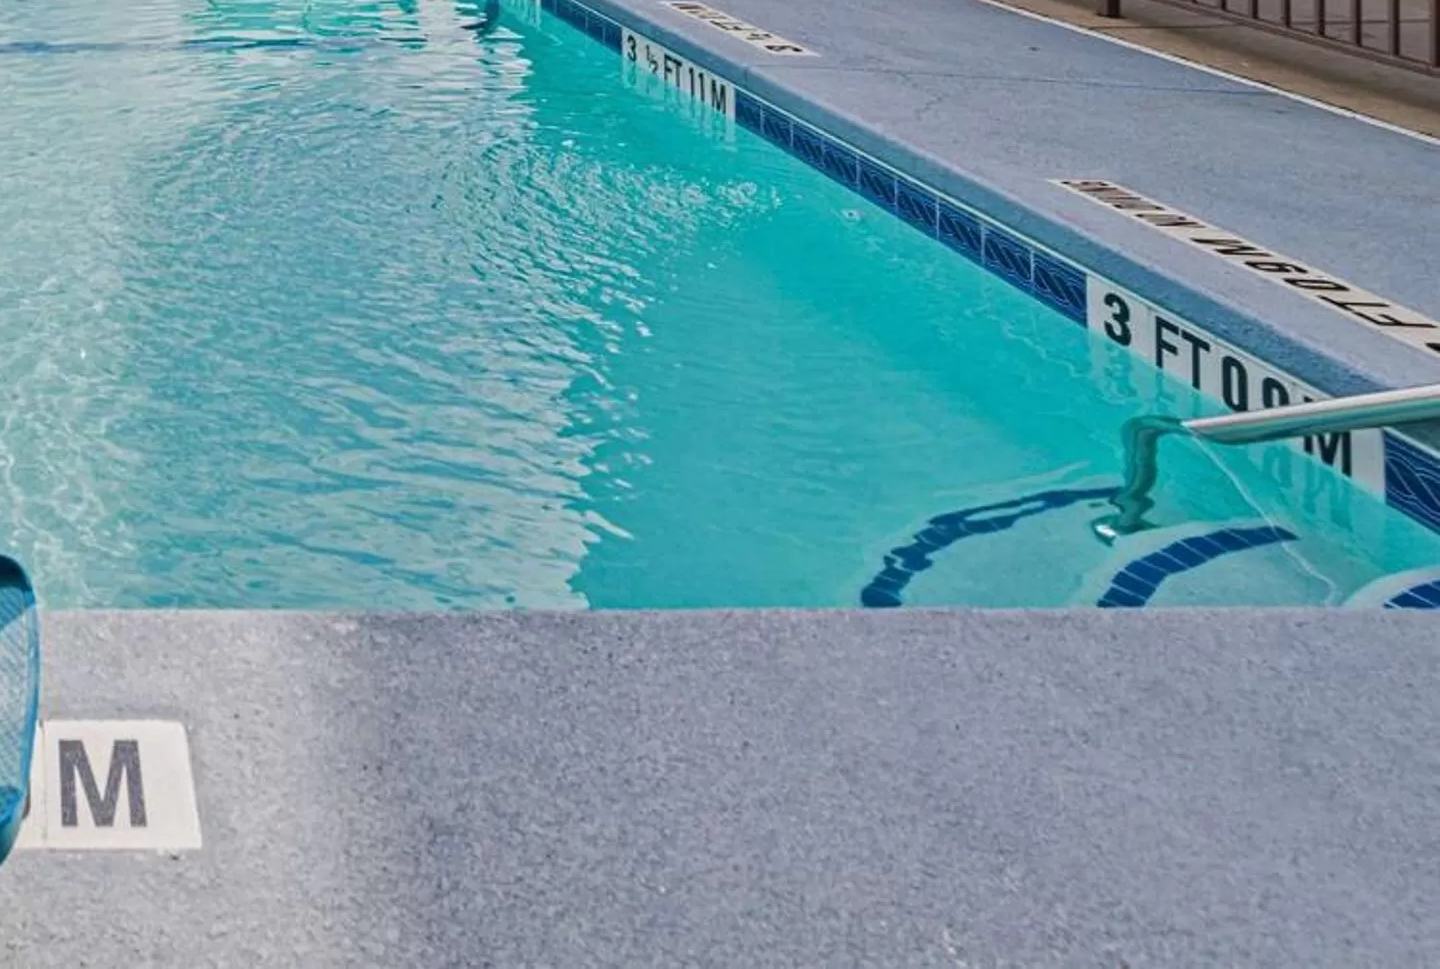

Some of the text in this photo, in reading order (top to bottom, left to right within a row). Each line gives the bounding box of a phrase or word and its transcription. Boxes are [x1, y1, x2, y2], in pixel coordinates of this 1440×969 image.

[627, 34, 637, 62] 3
[663, 53, 683, 87] FT
[1103, 292, 1132, 347] 3
[1155, 315, 1211, 391] FT
